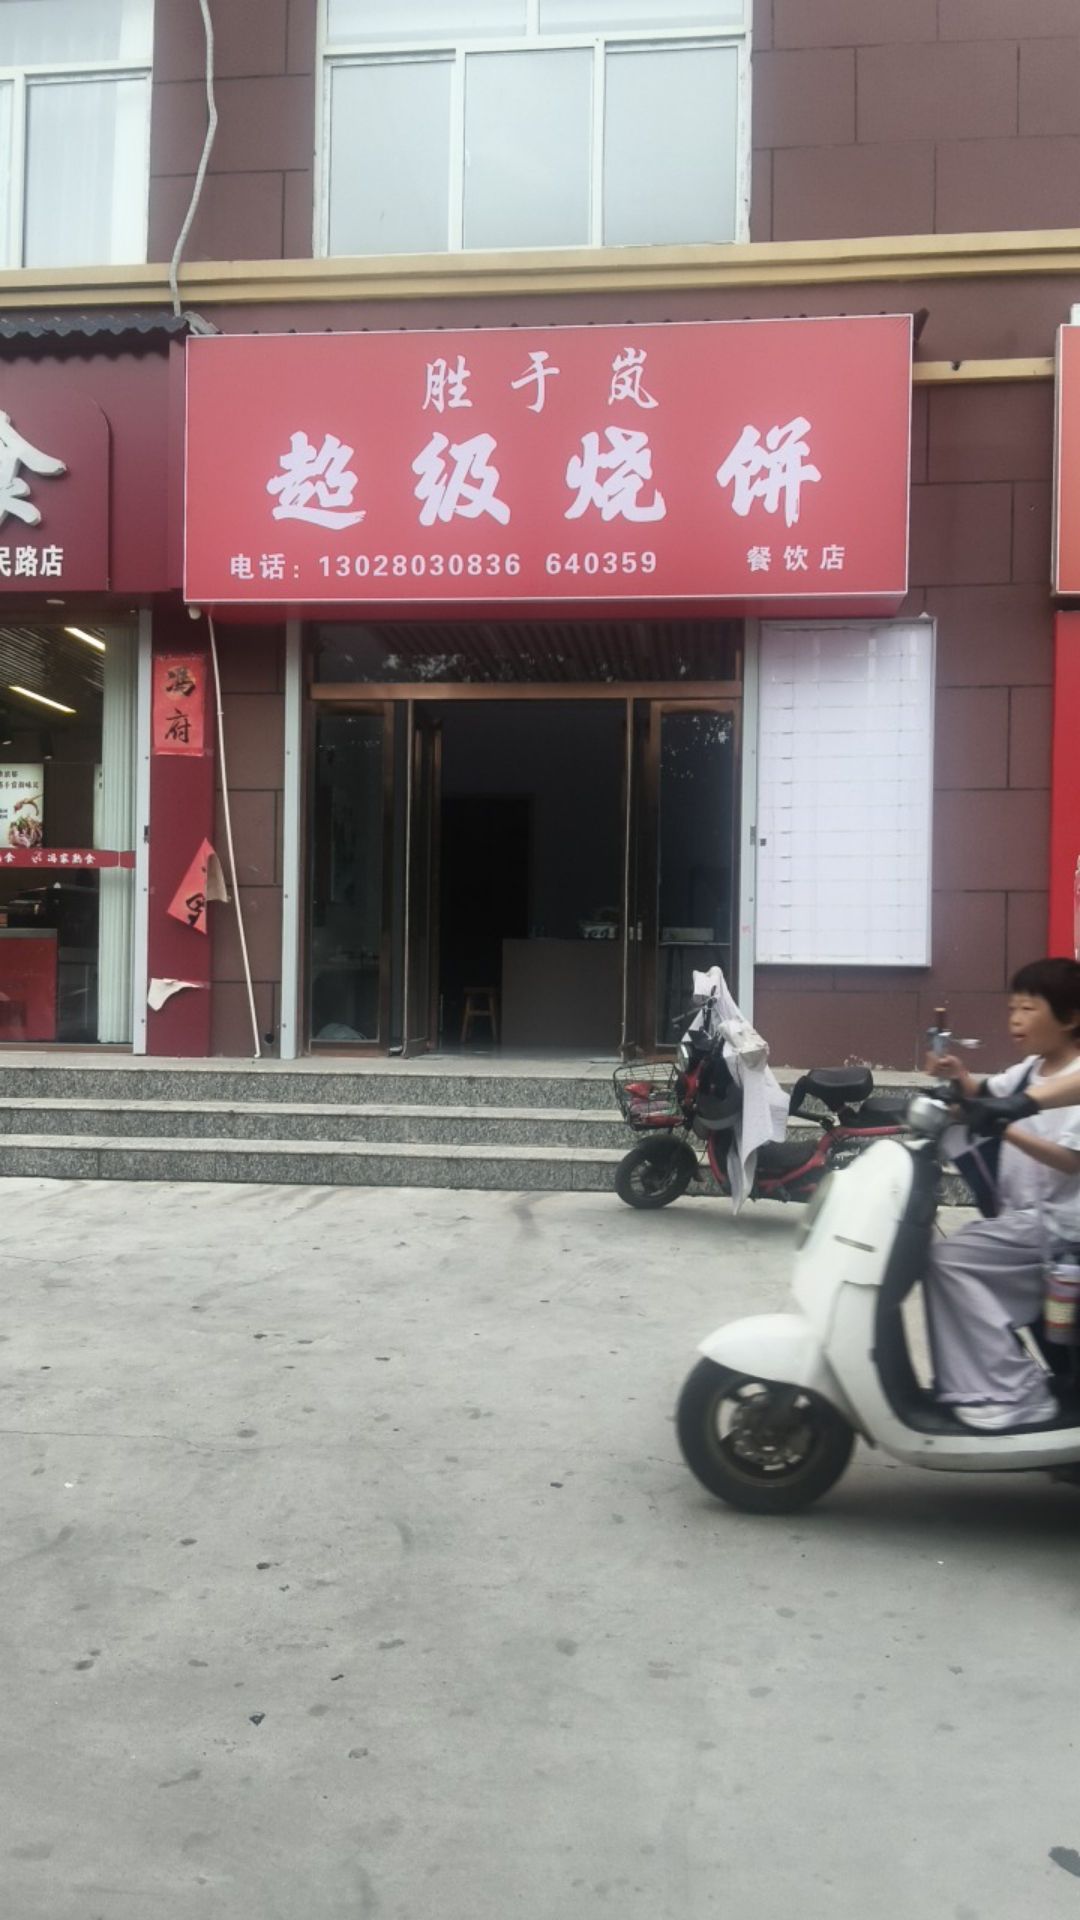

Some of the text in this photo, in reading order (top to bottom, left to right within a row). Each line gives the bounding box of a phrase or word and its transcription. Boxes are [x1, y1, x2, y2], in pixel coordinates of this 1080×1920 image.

[422, 347, 659, 413] 胜于岚
[266, 416, 822, 530] 超级烧饼
[545, 551, 657, 575] 640359
[747, 544, 845, 572] 餐饮店
